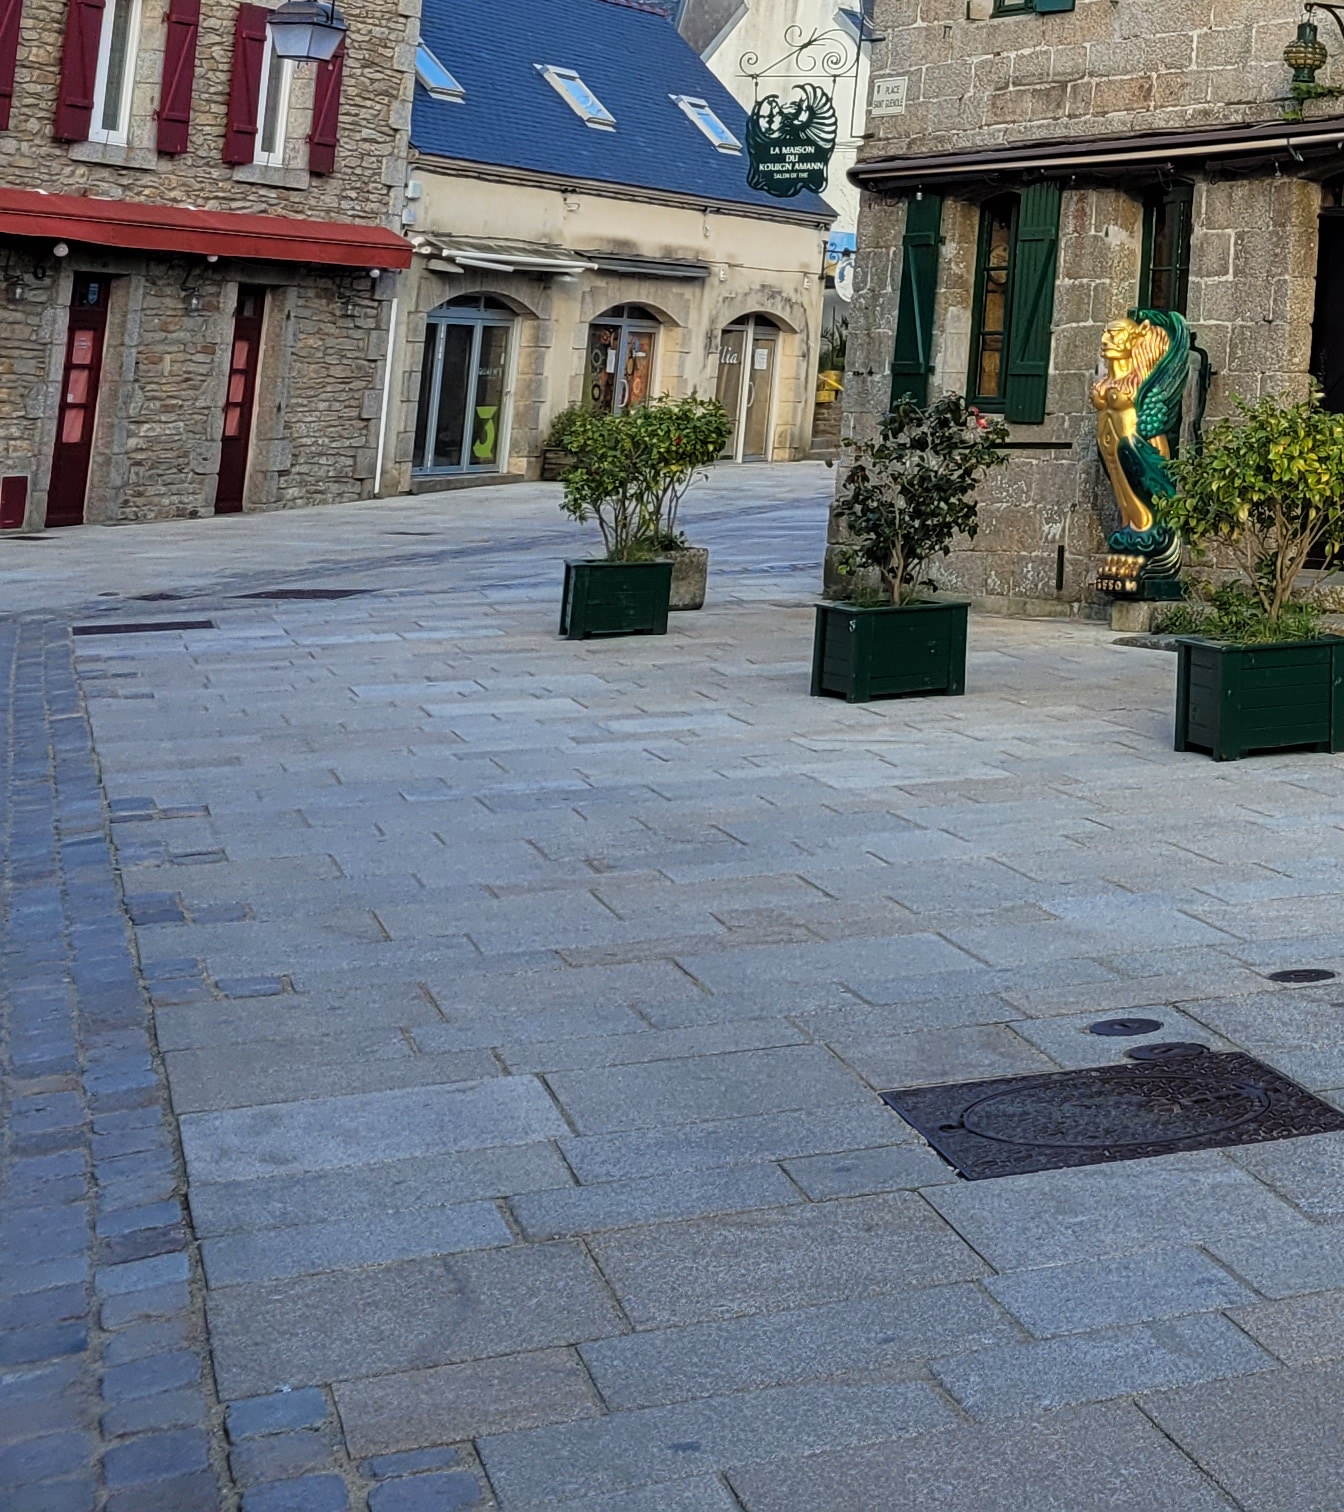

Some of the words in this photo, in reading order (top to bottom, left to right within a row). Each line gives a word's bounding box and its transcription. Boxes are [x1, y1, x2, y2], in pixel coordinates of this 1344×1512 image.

[770, 146, 780, 154] LA
[781, 145, 815, 154] MAISON
[785, 154, 799, 162] DU
[759, 162, 793, 171] KOUIGN
[793, 161, 824, 170] AMANN
